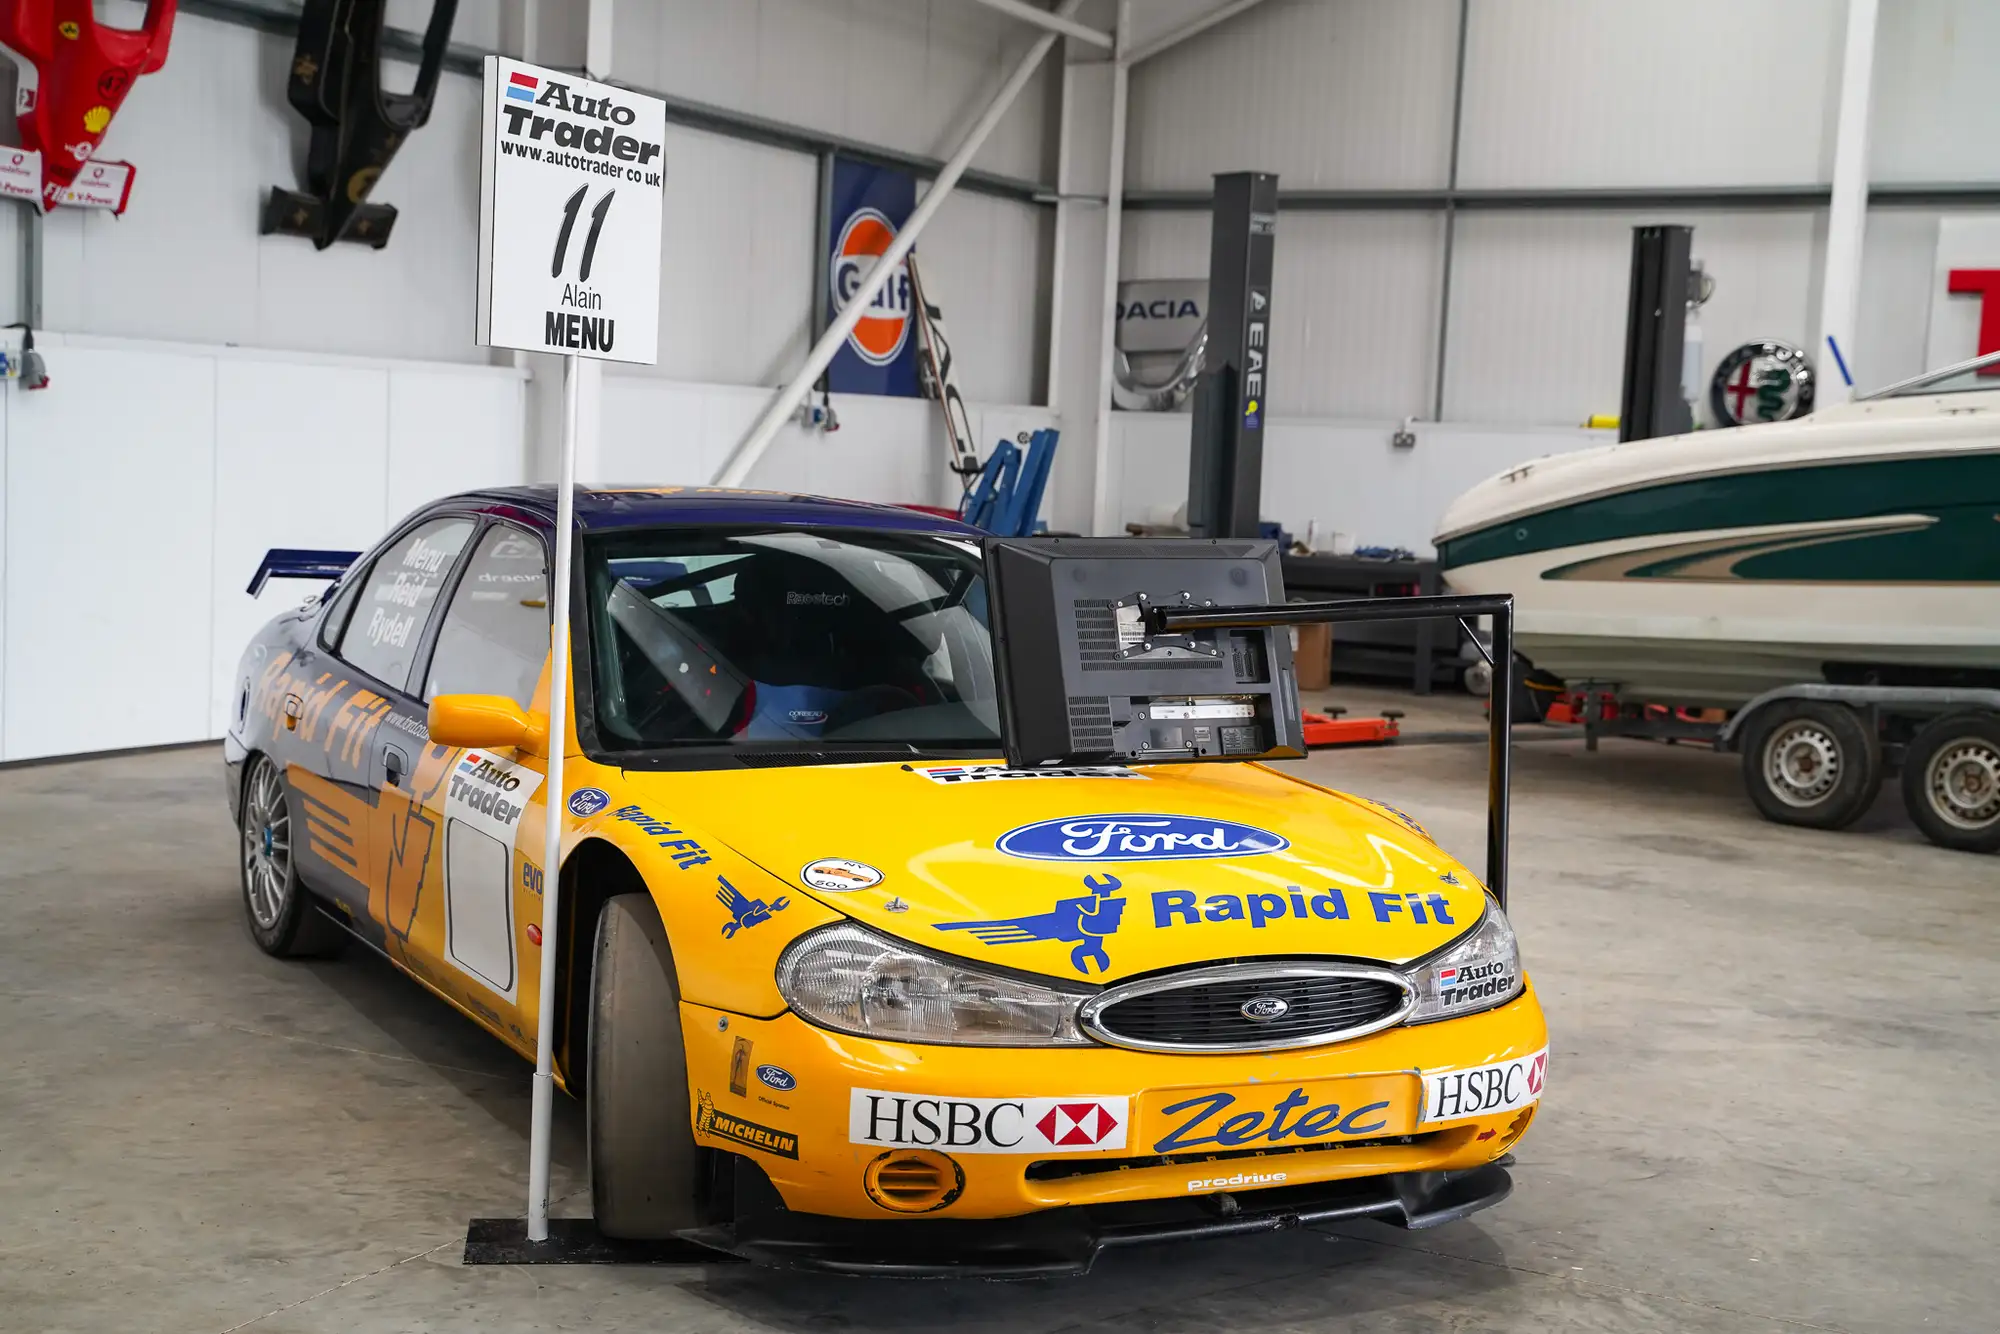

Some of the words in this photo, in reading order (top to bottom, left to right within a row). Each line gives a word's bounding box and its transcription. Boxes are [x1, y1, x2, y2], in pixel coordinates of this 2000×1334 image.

[536, 80, 636, 126] Auto
[503, 104, 661, 165] Trader
[501, 139, 624, 180] www.autotrader
[552, 182, 616, 283] 11
[561, 283, 602, 311] Alain
[545, 311, 614, 352] MENU
[1246, 322, 1265, 398] EAE
[402, 538, 447, 573] Menu
[386, 571, 427, 608] Reid
[367, 607, 415, 648] Rydell
[324, 689, 392, 769] Fit
[471, 759, 520, 792] Auto
[449, 775, 522, 826] Trader
[572, 790, 602, 813] Ford
[606, 805, 682, 836] Rapid
[658, 837, 712, 870] Fit
[1061, 816, 1241, 856] Ford
[523, 861, 543, 895] evo
[843, 861, 866, 870] NY
[1151, 885, 1350, 929] Rapid
[1368, 890, 1455, 925] Fit
[1440, 974, 1515, 1006] Trader
[1457, 961, 1504, 983] Auto
[1252, 999, 1280, 1015] Ford
[763, 1067, 788, 1087] Ford
[1433, 1062, 1524, 1119] HSBC
[714, 1116, 794, 1151] MICHELIN
[864, 1095, 1024, 1147] HSBC
[1153, 1087, 1390, 1153] Zetec
[1187, 1171, 1287, 1191] prodrive
